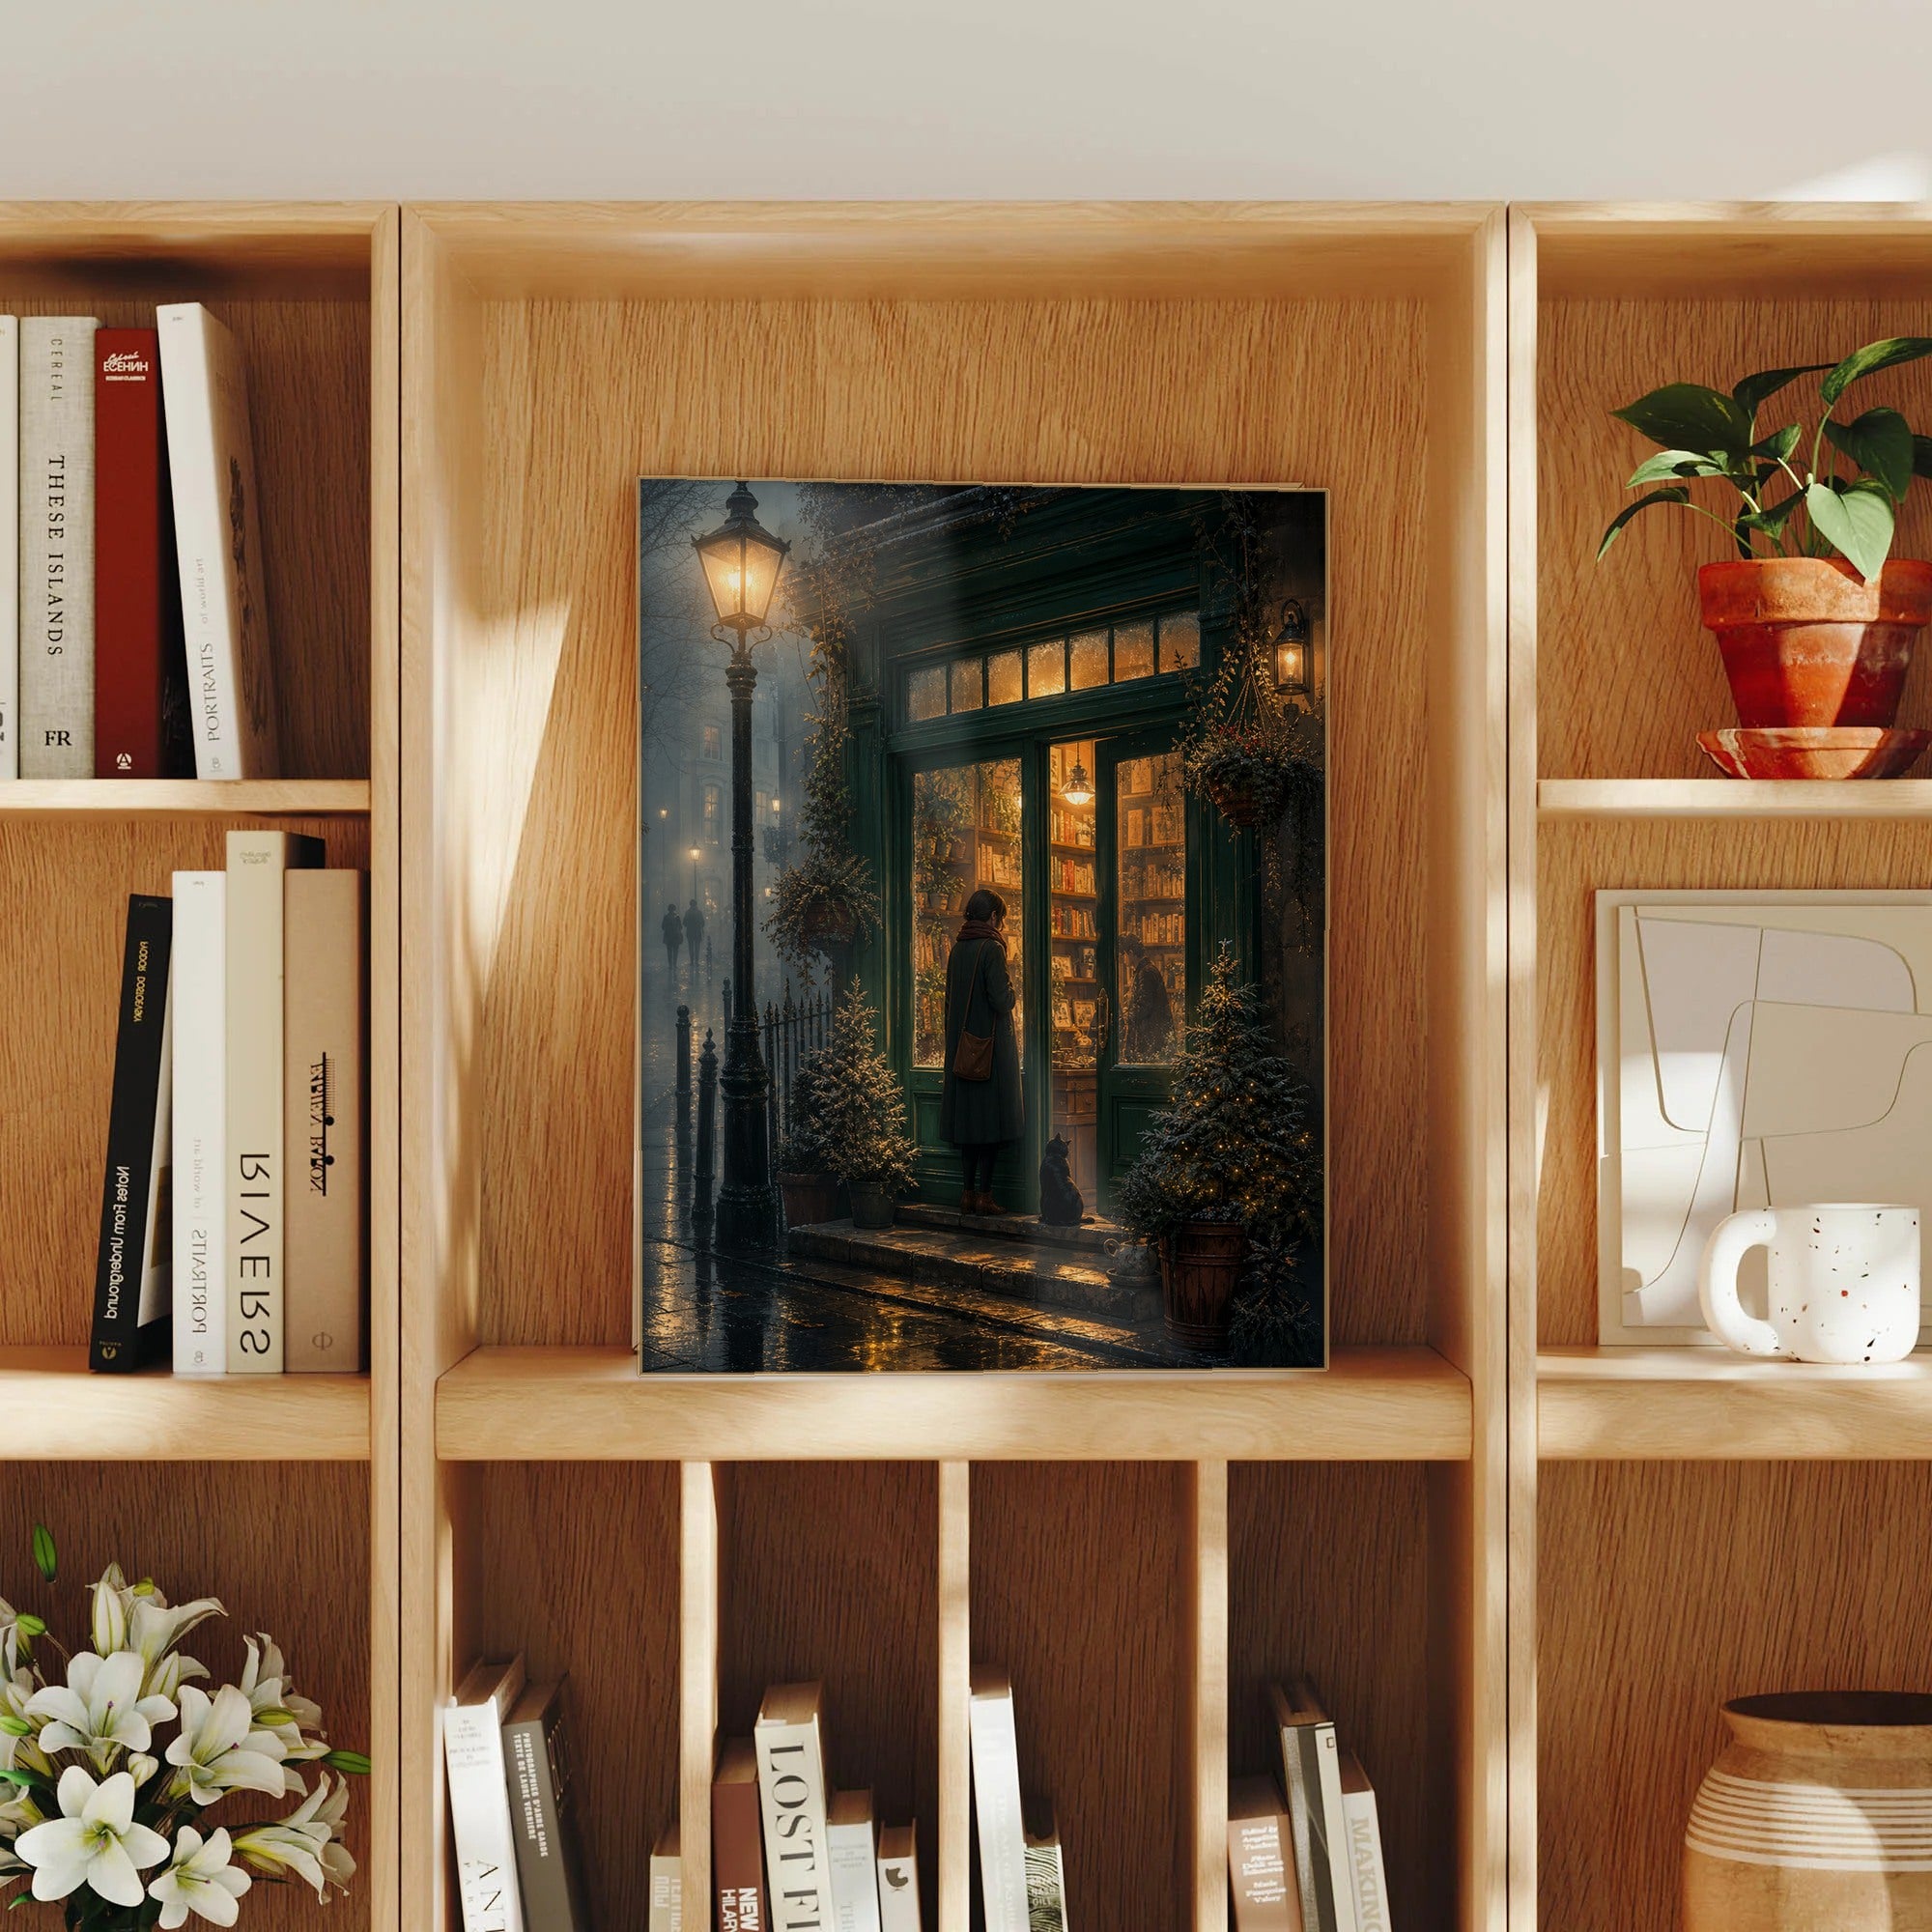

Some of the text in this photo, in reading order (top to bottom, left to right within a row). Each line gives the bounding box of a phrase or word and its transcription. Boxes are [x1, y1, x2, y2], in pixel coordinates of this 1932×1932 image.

[50, 338, 63, 401] CEREAL
[102, 361, 149, 372] ЕСЕНИН
[47, 455, 65, 657] THESE ISLANDS
[200, 642, 220, 742] PORTRAITS
[44, 730, 72, 747] FR
[769, 1744, 815, 1871] LOST
[738, 1887, 759, 1931] NEW
